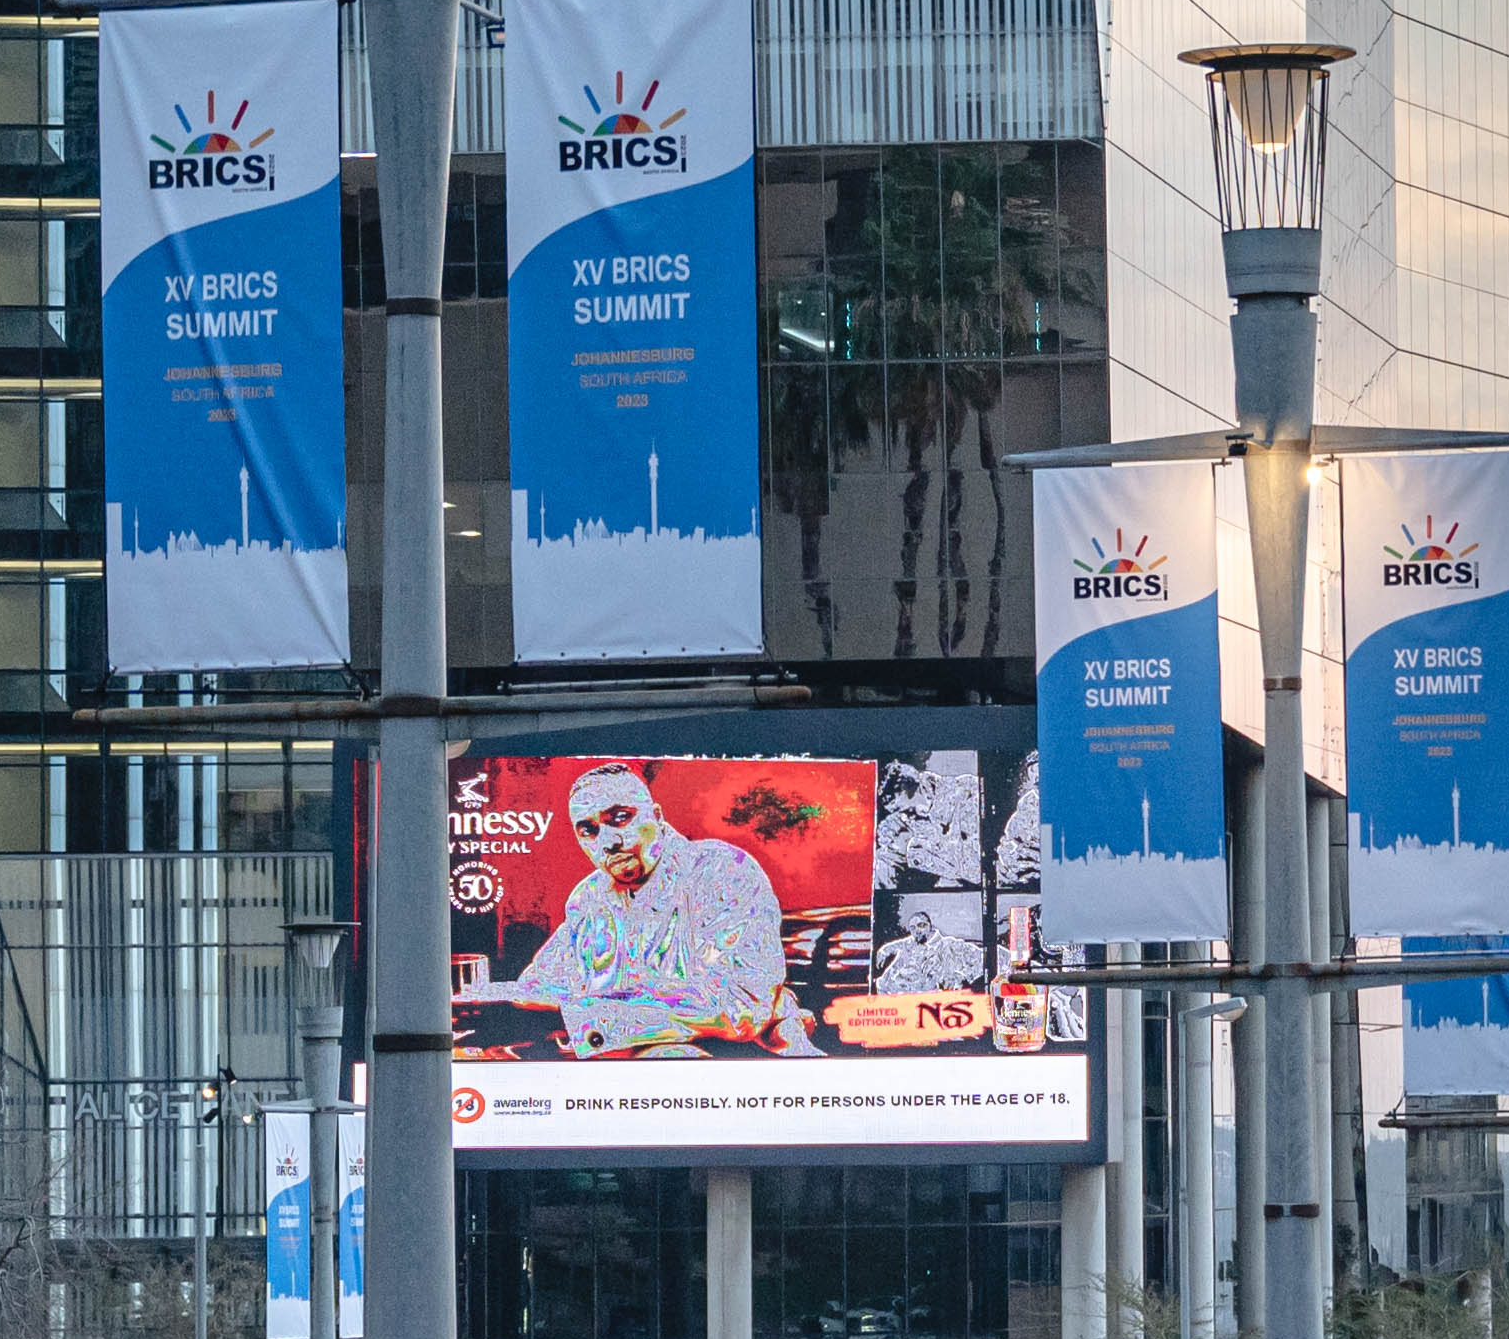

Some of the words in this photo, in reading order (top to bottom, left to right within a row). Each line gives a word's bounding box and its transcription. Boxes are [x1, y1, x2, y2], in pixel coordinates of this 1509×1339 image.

[559, 135, 678, 172] BRICS
[149, 154, 267, 190] BRICS
[572, 258, 606, 287] XV
[612, 254, 690, 284] BRICS
[164, 275, 194, 303] XV
[202, 270, 278, 301] BRICS
[574, 292, 691, 325] SUMMIT
[166, 309, 278, 340] SUMMIT
[571, 347, 694, 366] JOHANNESBURG
[580, 373, 630, 388] SOUTH
[632, 370, 688, 385] AFRICA
[616, 393, 648, 408] 2023
[1384, 562, 1473, 586] BRICS
[1074, 574, 1162, 599] BRICS
[1394, 649, 1418, 669] XV
[1424, 647, 1482, 668] BRICS
[1084, 660, 1108, 681] XV
[1113, 658, 1171, 680] BRICS
[1395, 674, 1483, 696] SUMMIT
[1085, 686, 1171, 708] SUMMIT
[448, 811, 554, 841] nnessy
[459, 841, 532, 854] SPECIAL
[458, 875, 493, 900] 50
[848, 1018, 893, 1027] EDITION
[894, 1017, 907, 1026] BY
[857, 1008, 899, 1017] LIMITED
[565, 1098, 614, 1110] DRINK
[619, 1097, 731, 1110] RESPONSIBLY.
[736, 1096, 769, 1108] NOT
[773, 1096, 805, 1108] FOR
[810, 1095, 886, 1108] PERSONS
[891, 1094, 946, 1106] UNDER
[950, 1094, 981, 1106] THE
[985, 1093, 1019, 1105] AGE
[1023, 1093, 1045, 1105] OF
[1049, 1093, 1071, 1105] 18.
[276, 1165, 298, 1176] BRICS
